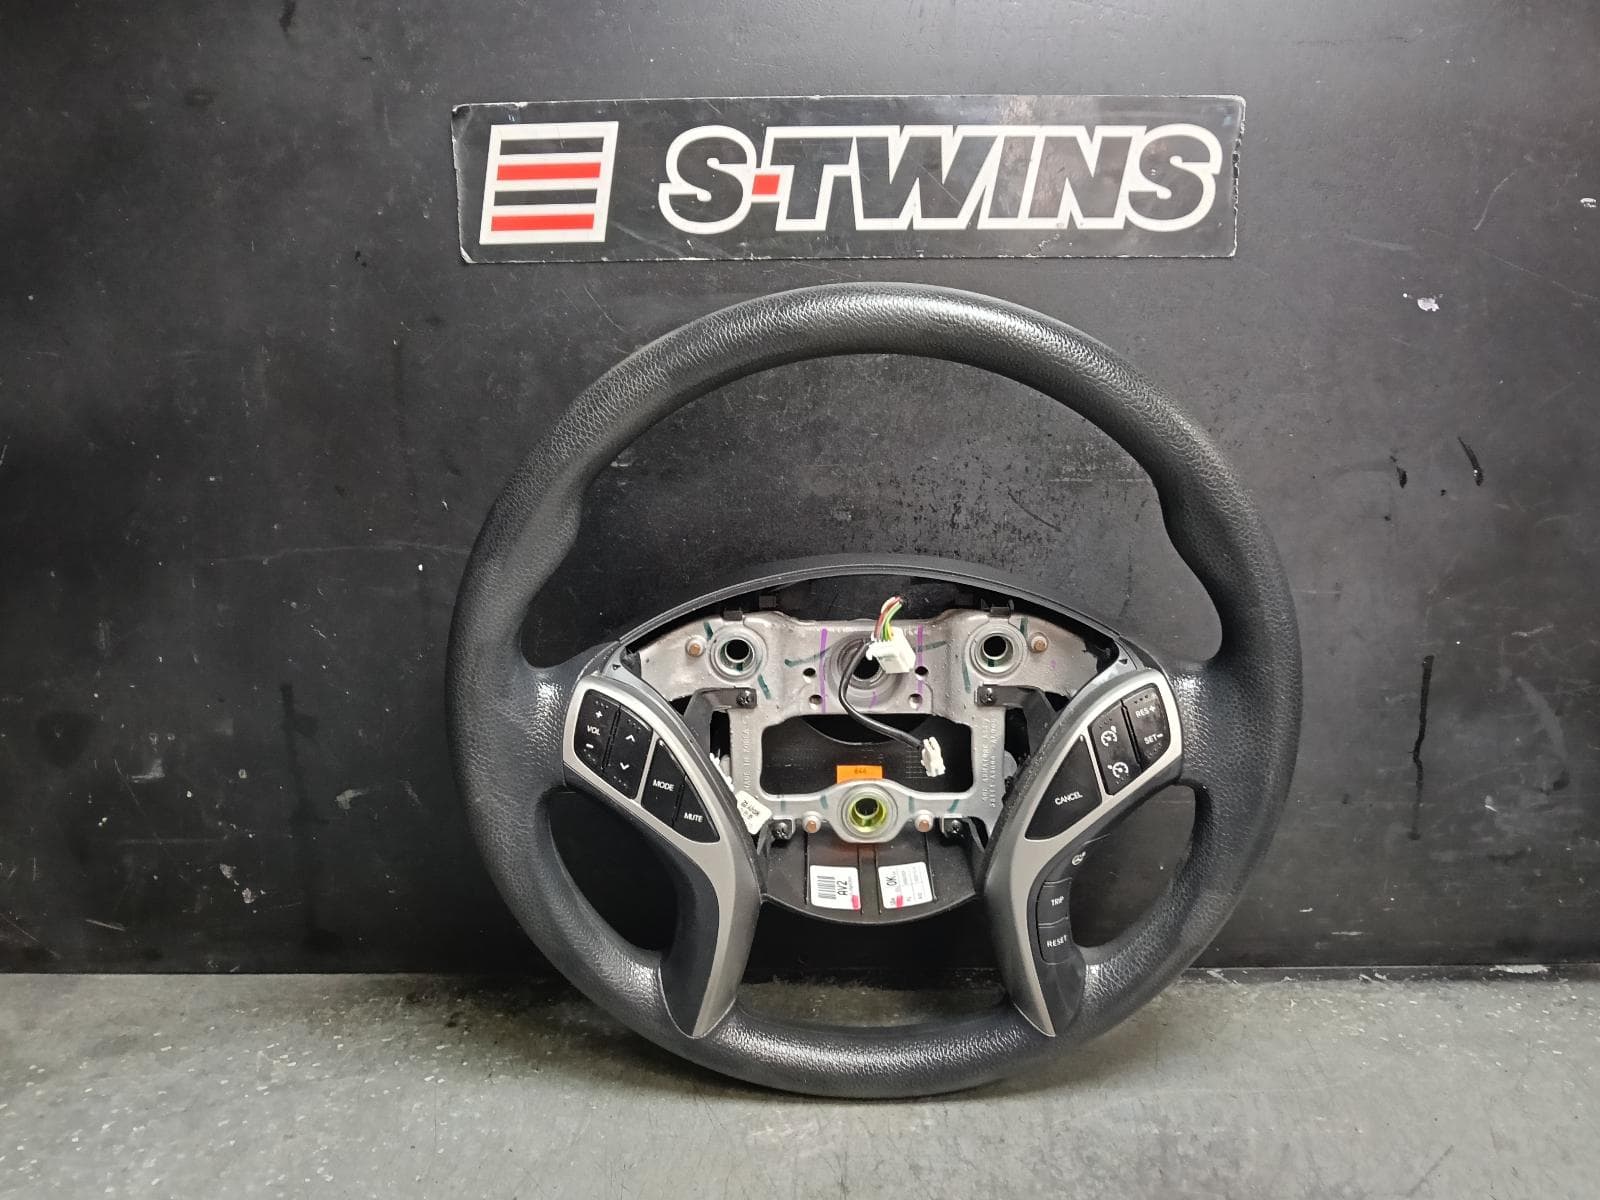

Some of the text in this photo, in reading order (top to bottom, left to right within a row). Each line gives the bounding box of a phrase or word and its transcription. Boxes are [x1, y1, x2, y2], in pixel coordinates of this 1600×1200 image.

[658, 124, 1223, 234] S-TWINS
[586, 724, 601, 736] VOL
[652, 779, 675, 792] MODE
[1054, 791, 1084, 806] CANCEL
[683, 811, 704, 823] MUTE
[836, 879, 849, 896] AV2
[1046, 934, 1068, 948] RESET
